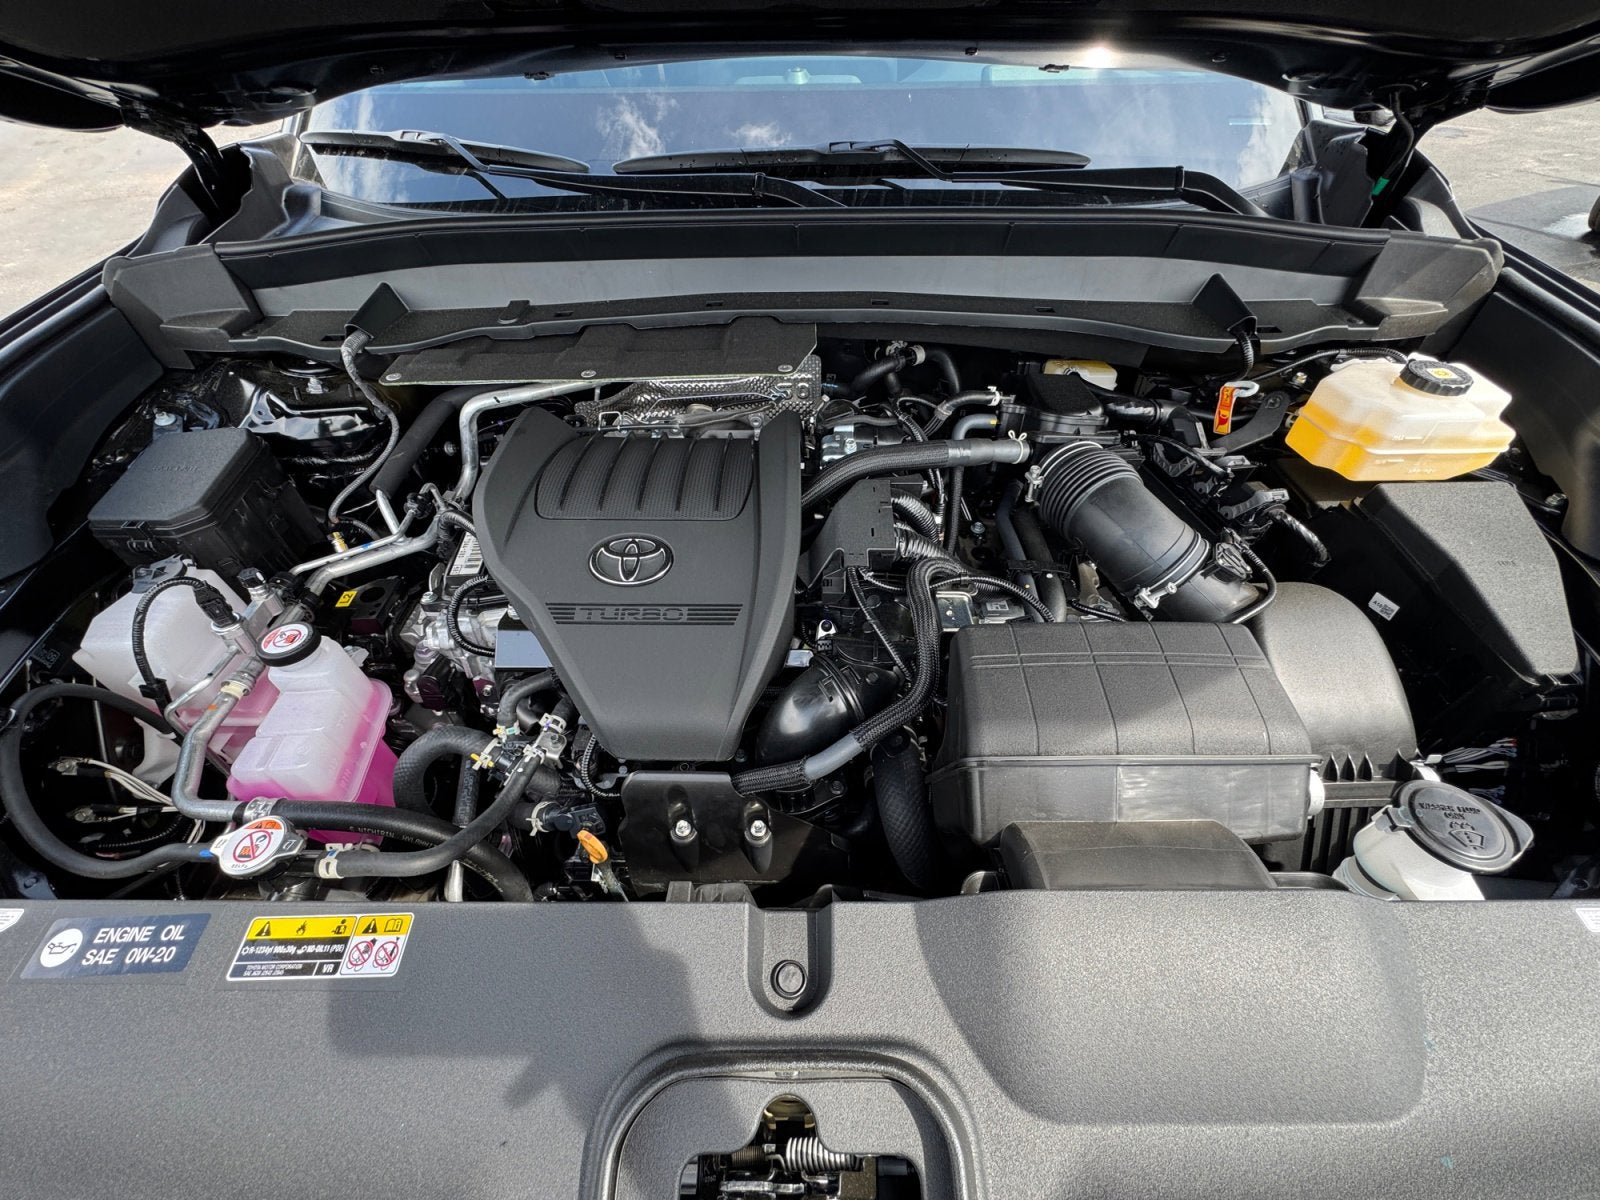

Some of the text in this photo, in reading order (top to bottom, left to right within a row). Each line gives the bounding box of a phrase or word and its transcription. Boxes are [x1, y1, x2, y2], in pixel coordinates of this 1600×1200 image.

[579, 606, 684, 621] TURBO
[93, 924, 186, 944] ENGINE OIL
[82, 946, 177, 966] SAE 0W-20
[322, 963, 335, 973] VR
